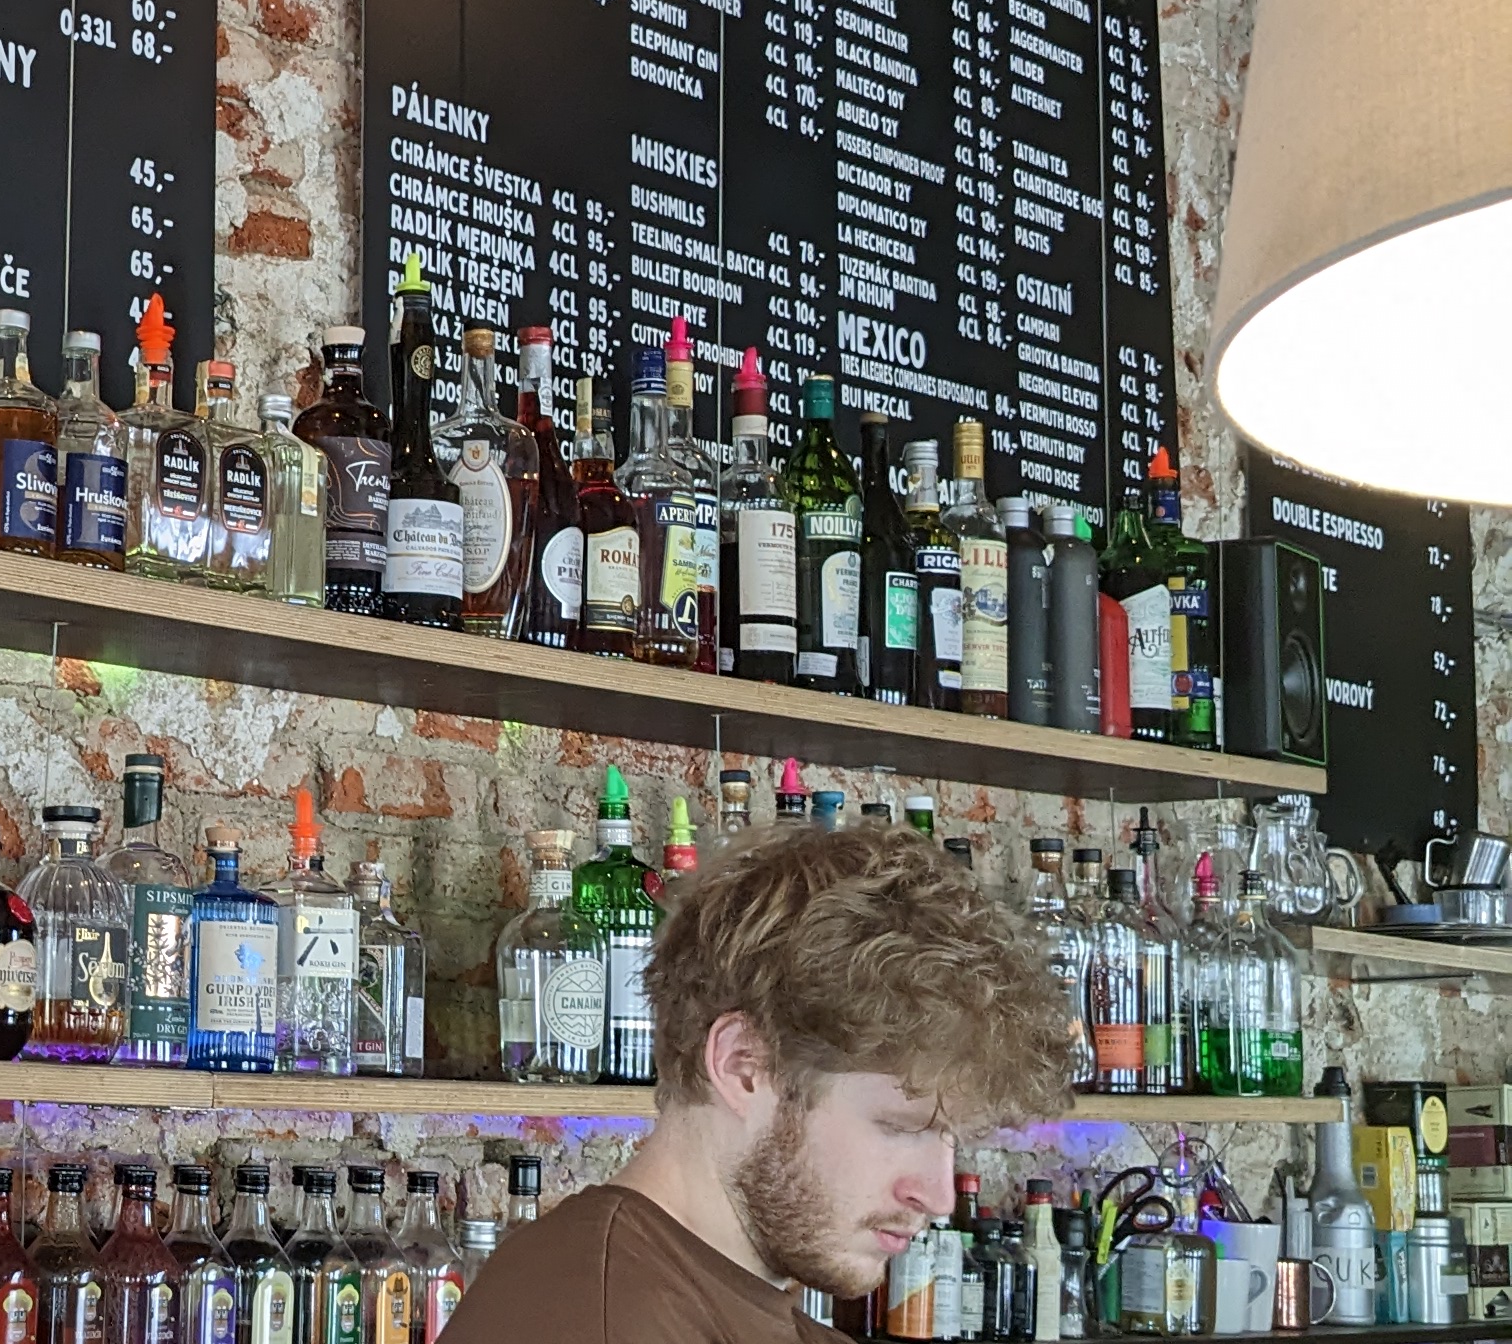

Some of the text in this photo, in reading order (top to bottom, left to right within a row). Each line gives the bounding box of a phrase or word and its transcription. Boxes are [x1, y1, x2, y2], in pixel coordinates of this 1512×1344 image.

[631, 24, 693, 64] ELEPHANT
[631, 56, 703, 100] BOROVIČKA
[836, 68, 885, 103] MALTECO
[392, 82, 489, 143] PÁLENKY
[391, 137, 542, 207] CHRÁMCE ŠVESTKA
[631, 134, 717, 189] WHISKIES
[390, 172, 535, 237] CHRÁMCE HRUŠKA
[631, 185, 705, 228] BUSHMILLS
[458, 227, 535, 271] MERUŇKA
[631, 255, 742, 305] BULLEIT BOURBON
[1016, 273, 1073, 316] OSTATNÍ
[838, 310, 926, 370] MEXICO
[1017, 313, 1060, 343] CAMPARI
[809, 514, 858, 537] NOILLY
[1272, 497, 1383, 551] DOUBLE ESPRESSO
